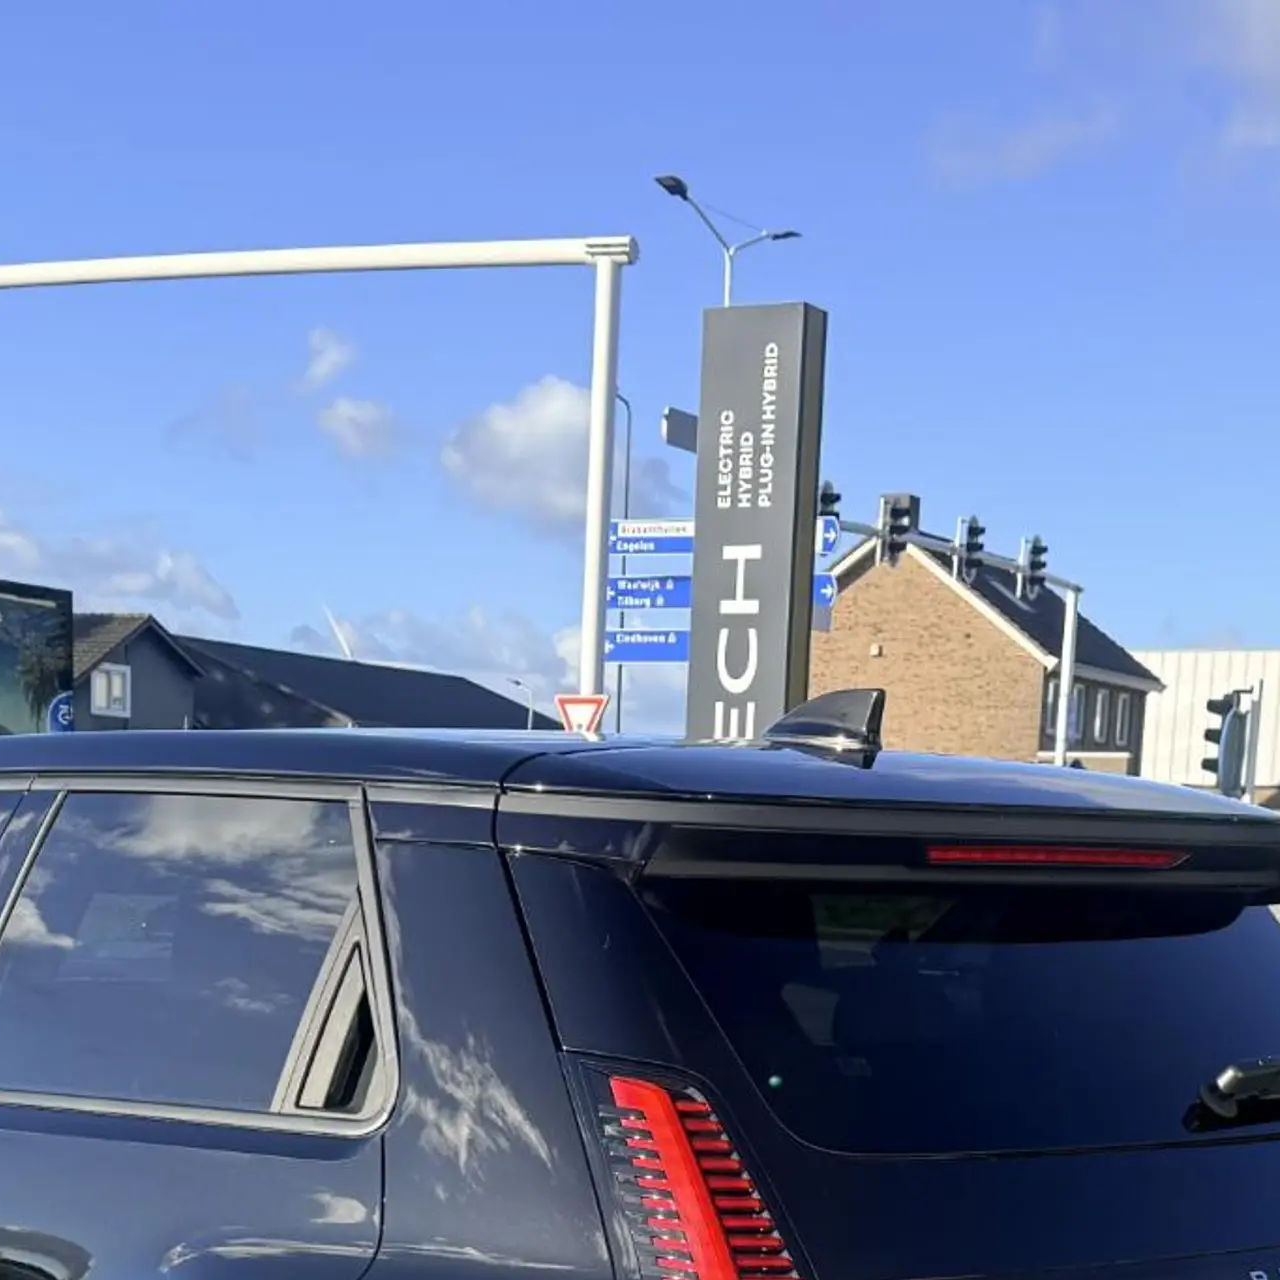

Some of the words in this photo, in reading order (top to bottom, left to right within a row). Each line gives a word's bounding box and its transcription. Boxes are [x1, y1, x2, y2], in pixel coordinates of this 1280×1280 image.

[762, 342, 778, 420] HYBRID
[717, 409, 734, 509] ELECTRIC
[738, 431, 754, 508] HYBRID
[758, 423, 775, 508] PLUG-IN
